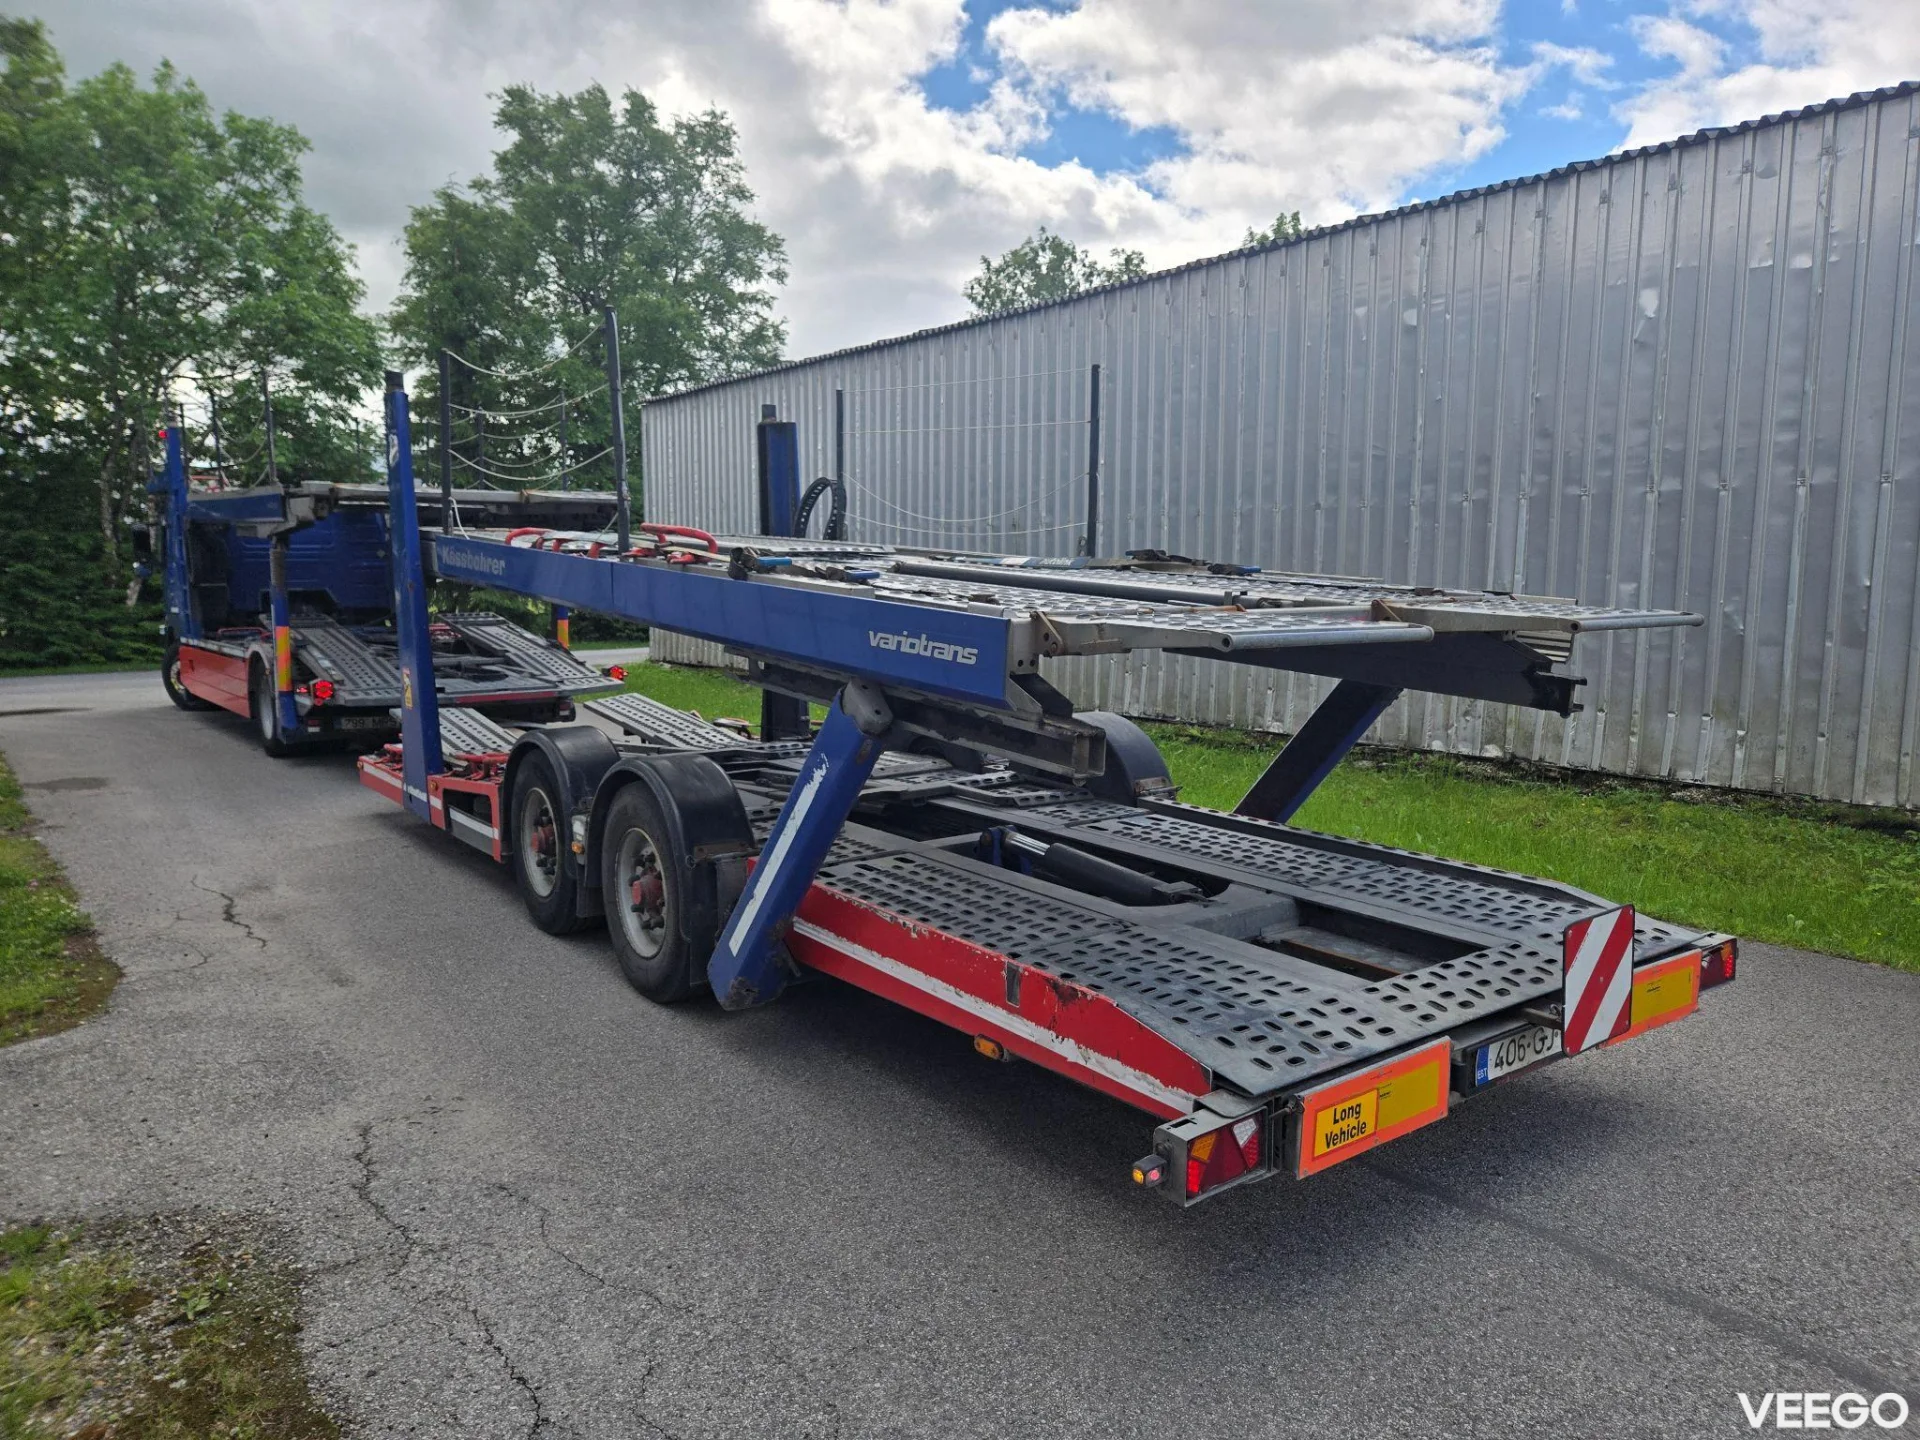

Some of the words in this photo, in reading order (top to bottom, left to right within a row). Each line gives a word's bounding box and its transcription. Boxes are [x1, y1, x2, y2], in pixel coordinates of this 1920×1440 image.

[868, 630, 979, 665] variotrans
[1477, 1067, 1488, 1080] EST
[1333, 1102, 1362, 1125] Long
[1325, 1120, 1367, 1149] Vehicle
